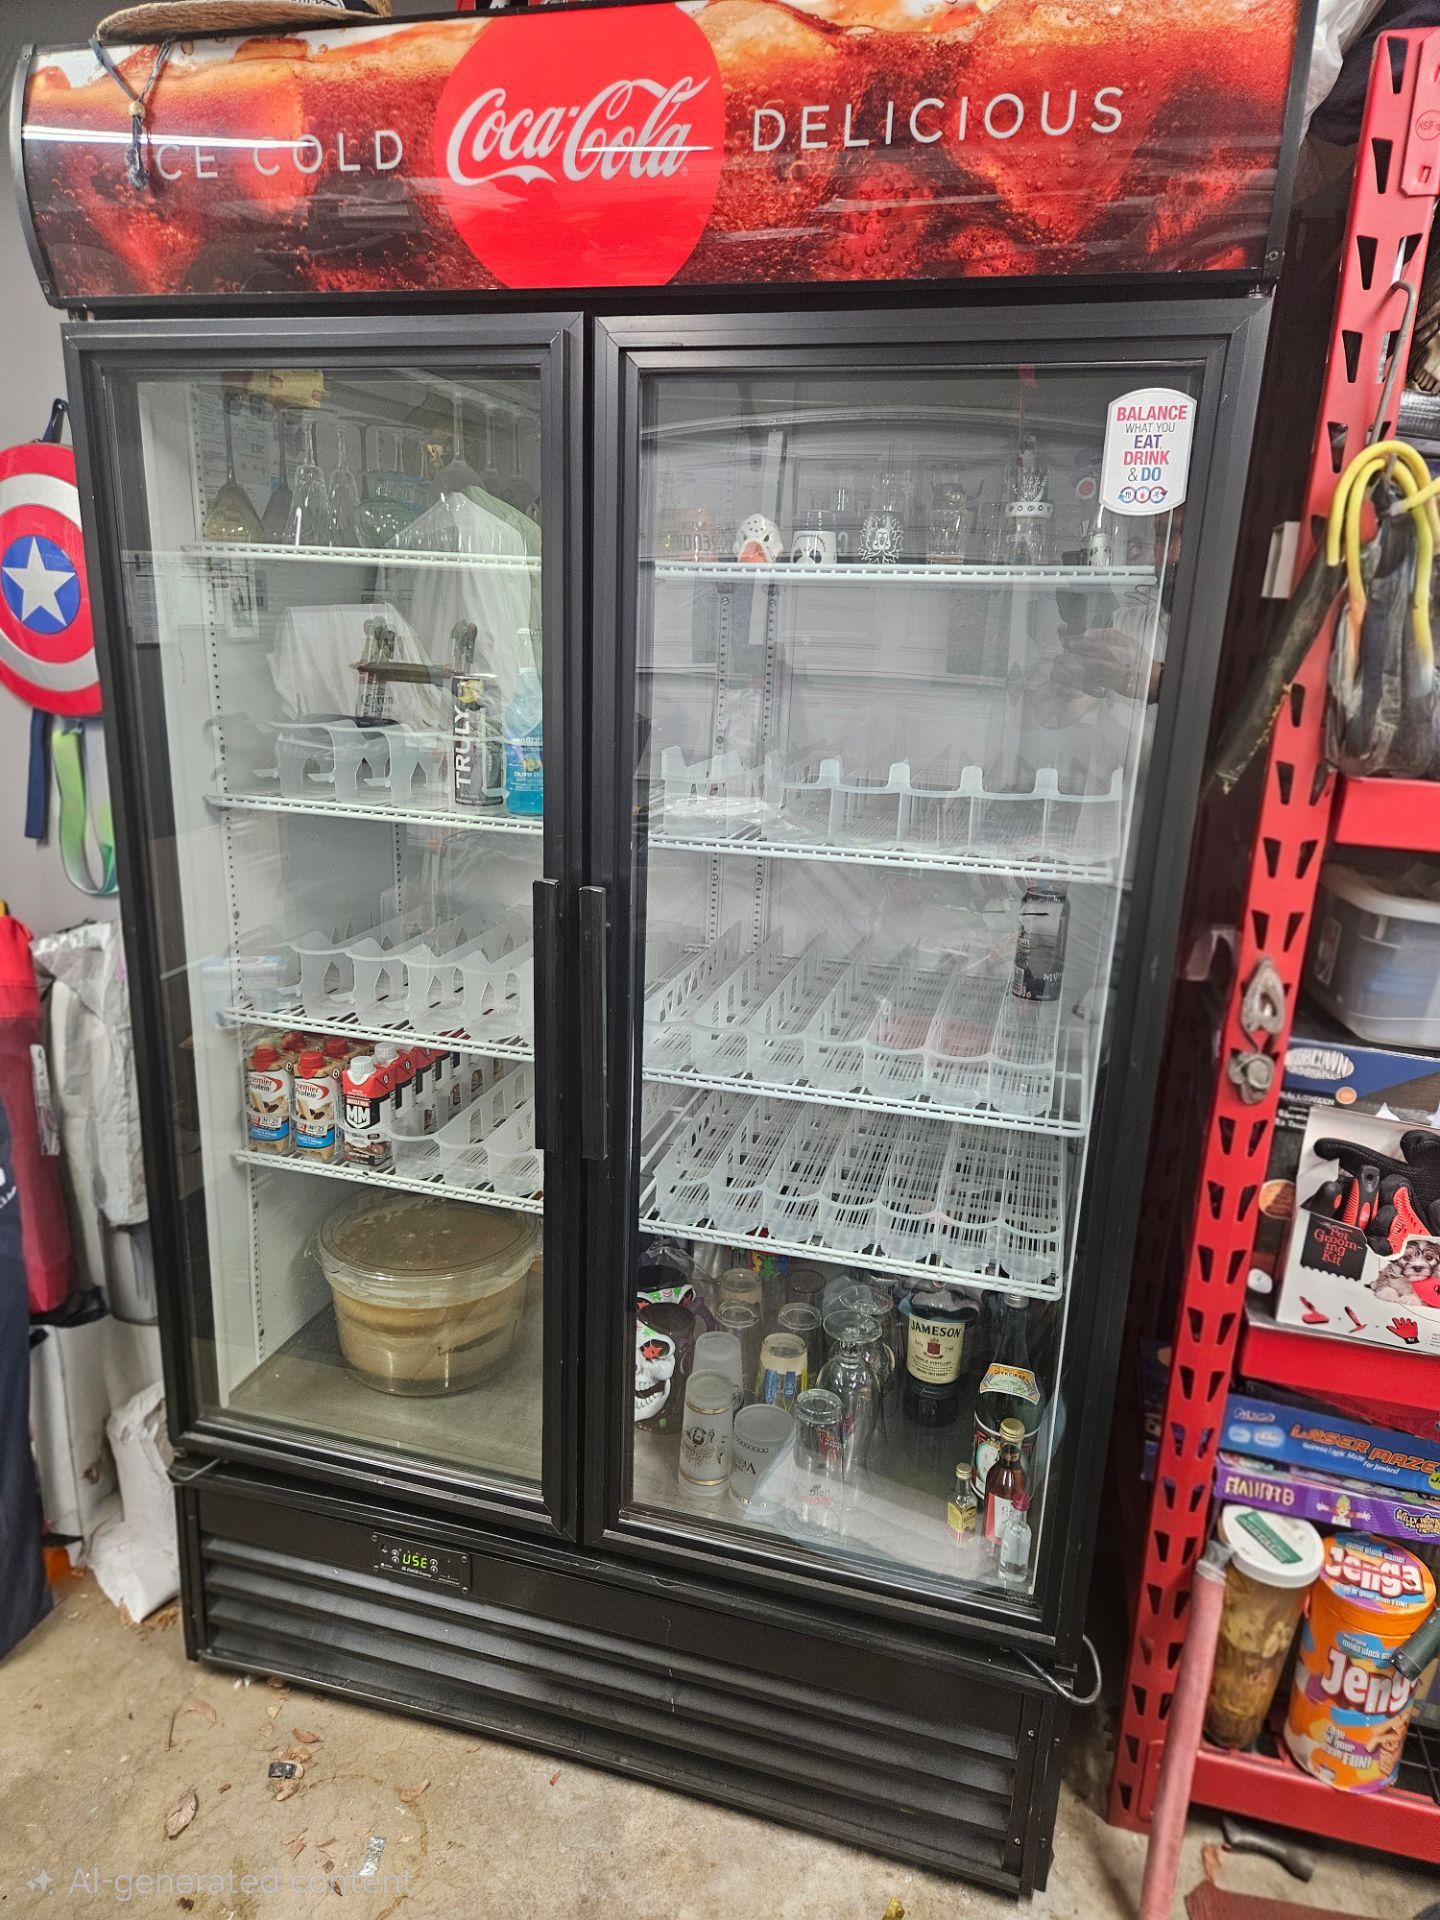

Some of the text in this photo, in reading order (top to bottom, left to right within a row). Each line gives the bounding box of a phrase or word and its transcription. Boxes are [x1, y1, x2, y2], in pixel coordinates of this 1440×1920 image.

[752, 86, 1124, 153] DELICIOUS
[446, 76, 711, 186] Coca-Cola
[155, 128, 404, 181] CE COLD
[1116, 405, 1188, 421] BALANCE
[1125, 422, 1175, 433] WHAT YOU
[1123, 450, 1170, 466] DRINK
[1127, 466, 1162, 482] & DO
[454, 704, 473, 789] TRULY
[297, 1089, 318, 1099] rotein
[346, 1104, 371, 1124] MM
[1330, 1225, 1349, 1239] Pet
[1322, 1250, 1342, 1266] Kit
[1326, 1242, 1346, 1257] ing
[910, 1320, 962, 1338] JAMESON
[1290, 1424, 1440, 1475] LASER MAZE
[402, 1553, 428, 1569] USE
[1324, 1546, 1424, 1597] Jenga
[1320, 1648, 1418, 1713] Jeng
[1342, 1752, 1373, 1769] FUN!
